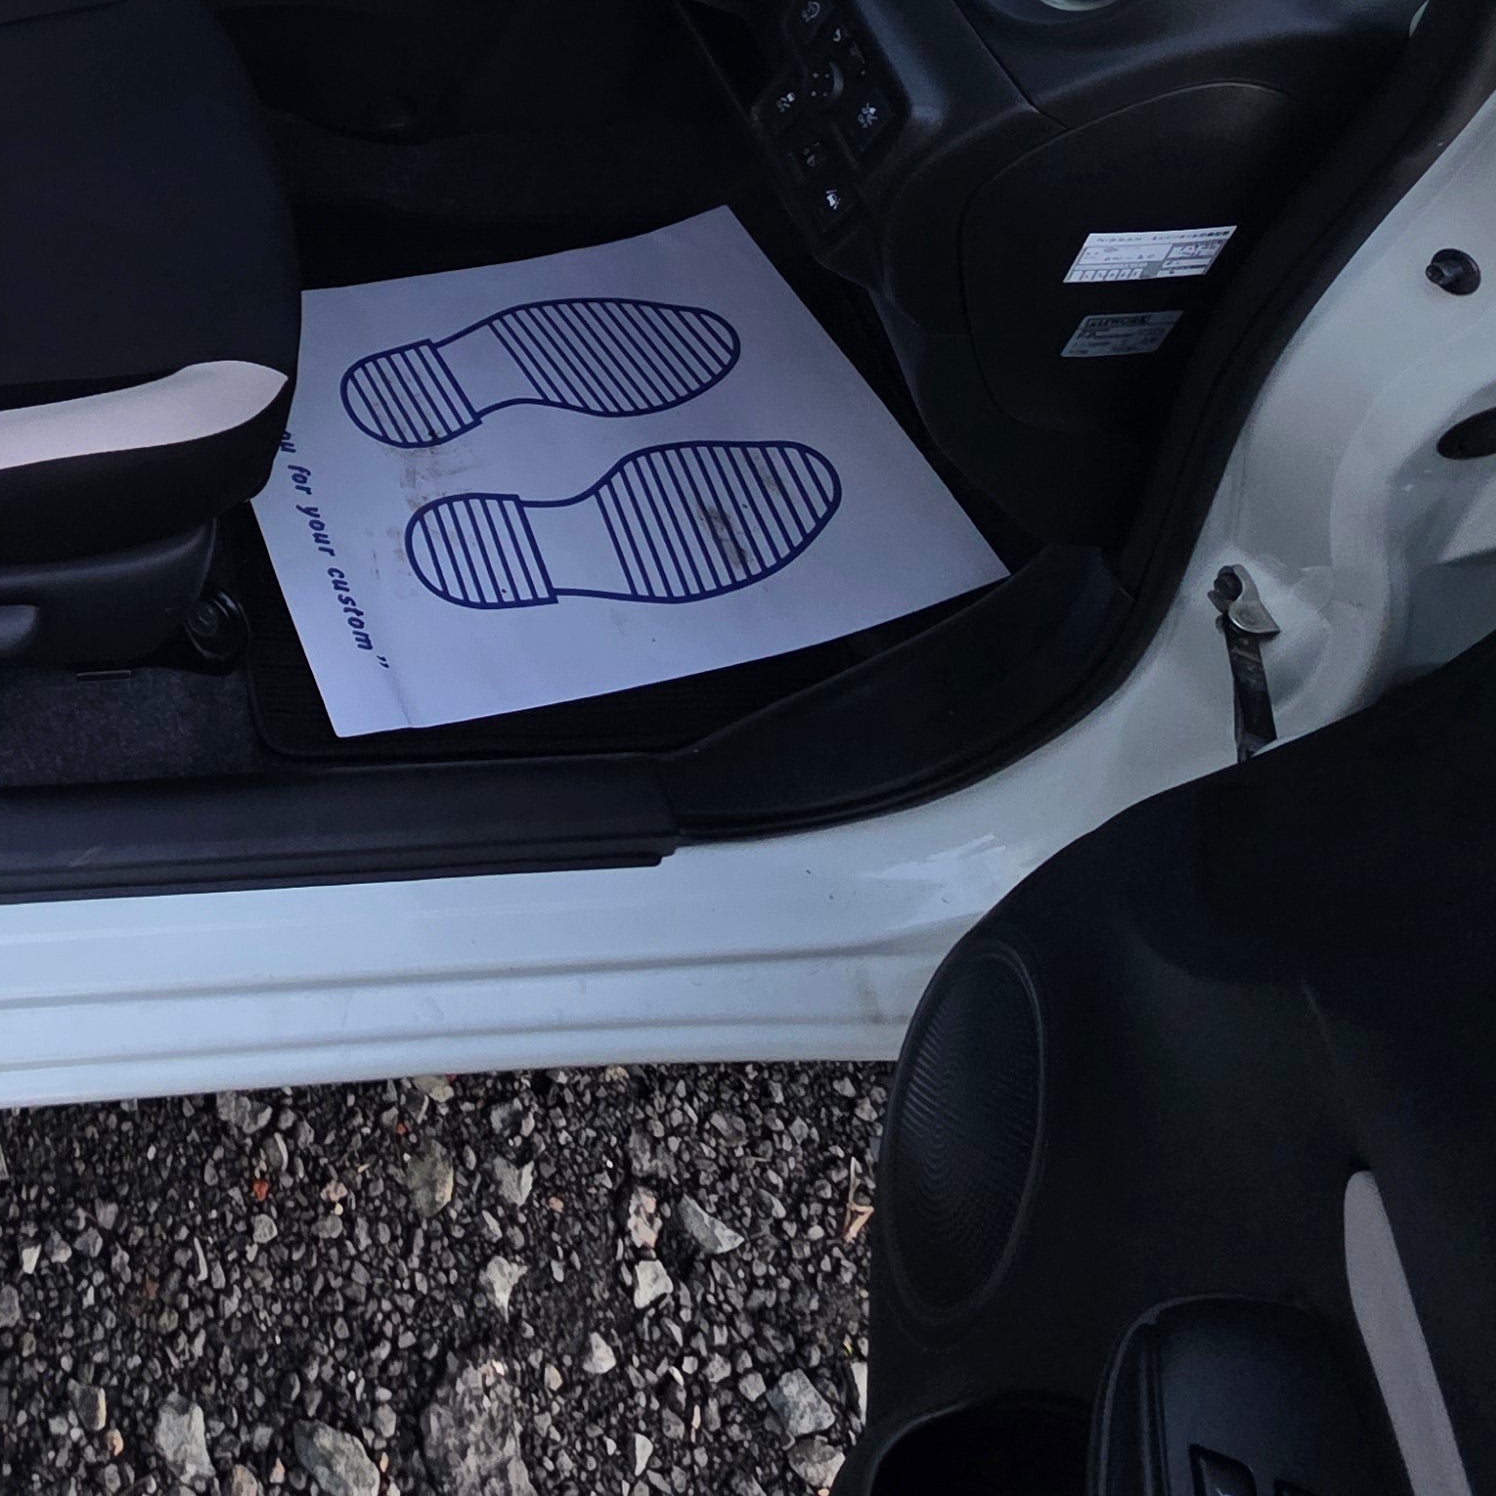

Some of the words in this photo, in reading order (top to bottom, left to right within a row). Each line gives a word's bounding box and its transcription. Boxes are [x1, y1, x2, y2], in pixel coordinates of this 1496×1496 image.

[287, 464, 312, 495] for
[295, 504, 336, 557] your
[327, 566, 373, 651] custom
